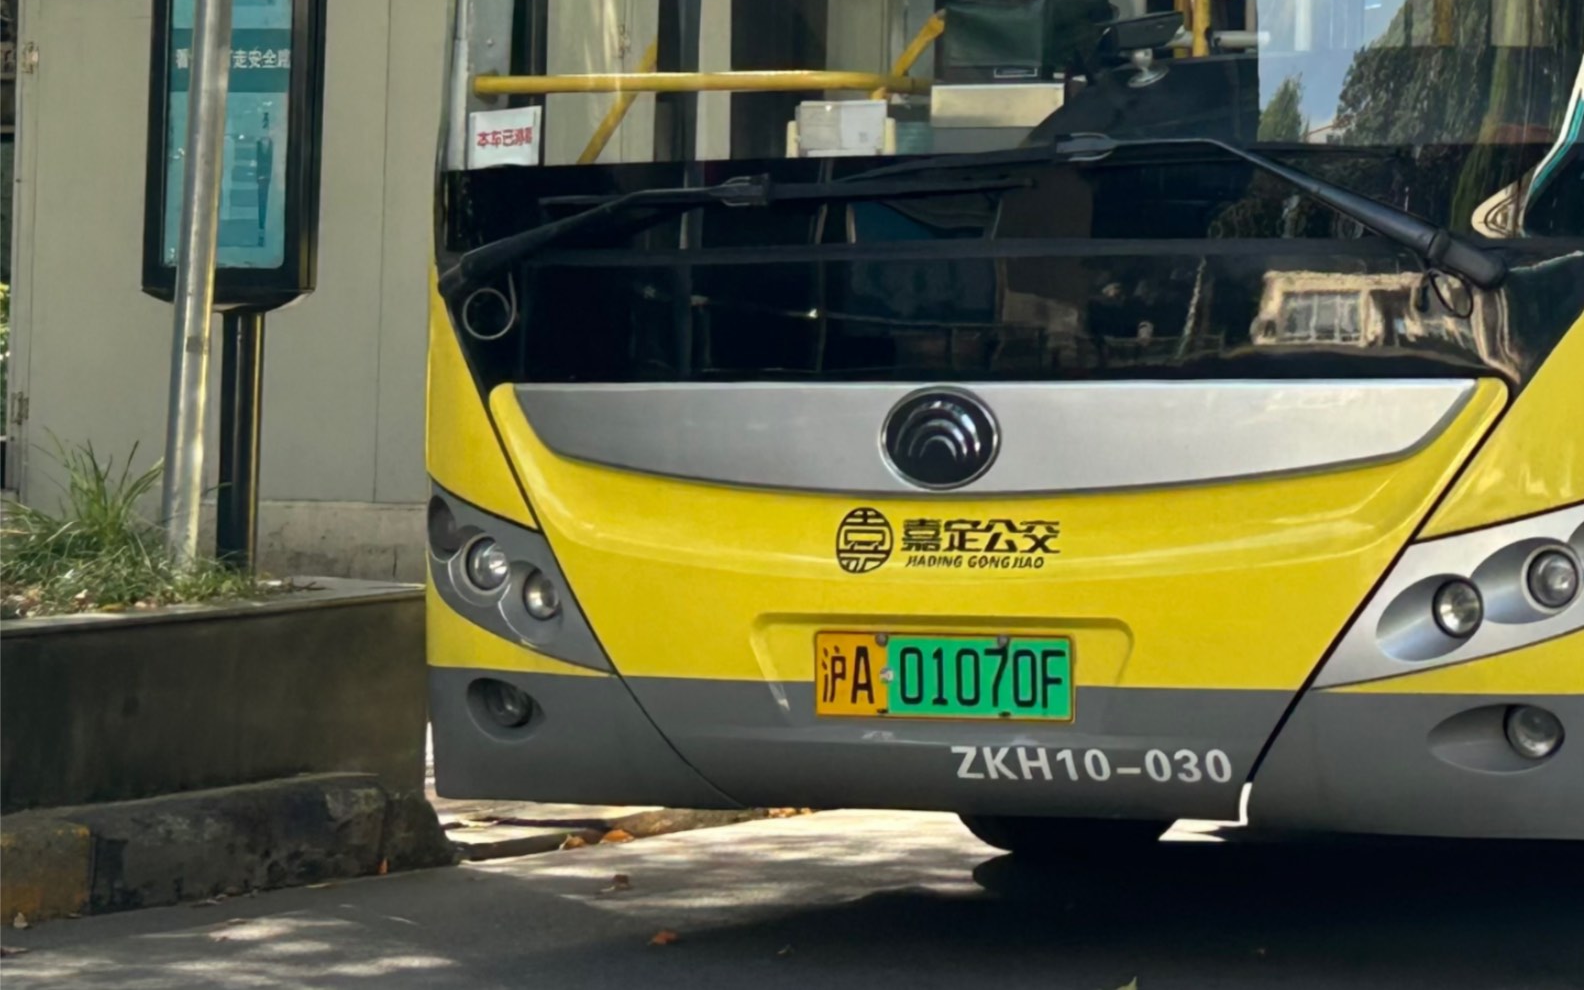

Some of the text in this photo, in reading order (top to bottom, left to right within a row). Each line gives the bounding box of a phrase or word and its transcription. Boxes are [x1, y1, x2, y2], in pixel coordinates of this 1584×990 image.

[901, 519, 1060, 555] 嘉定公交
[905, 555, 963, 569] JIADING
[951, 746, 1232, 783] ZKH10-030
